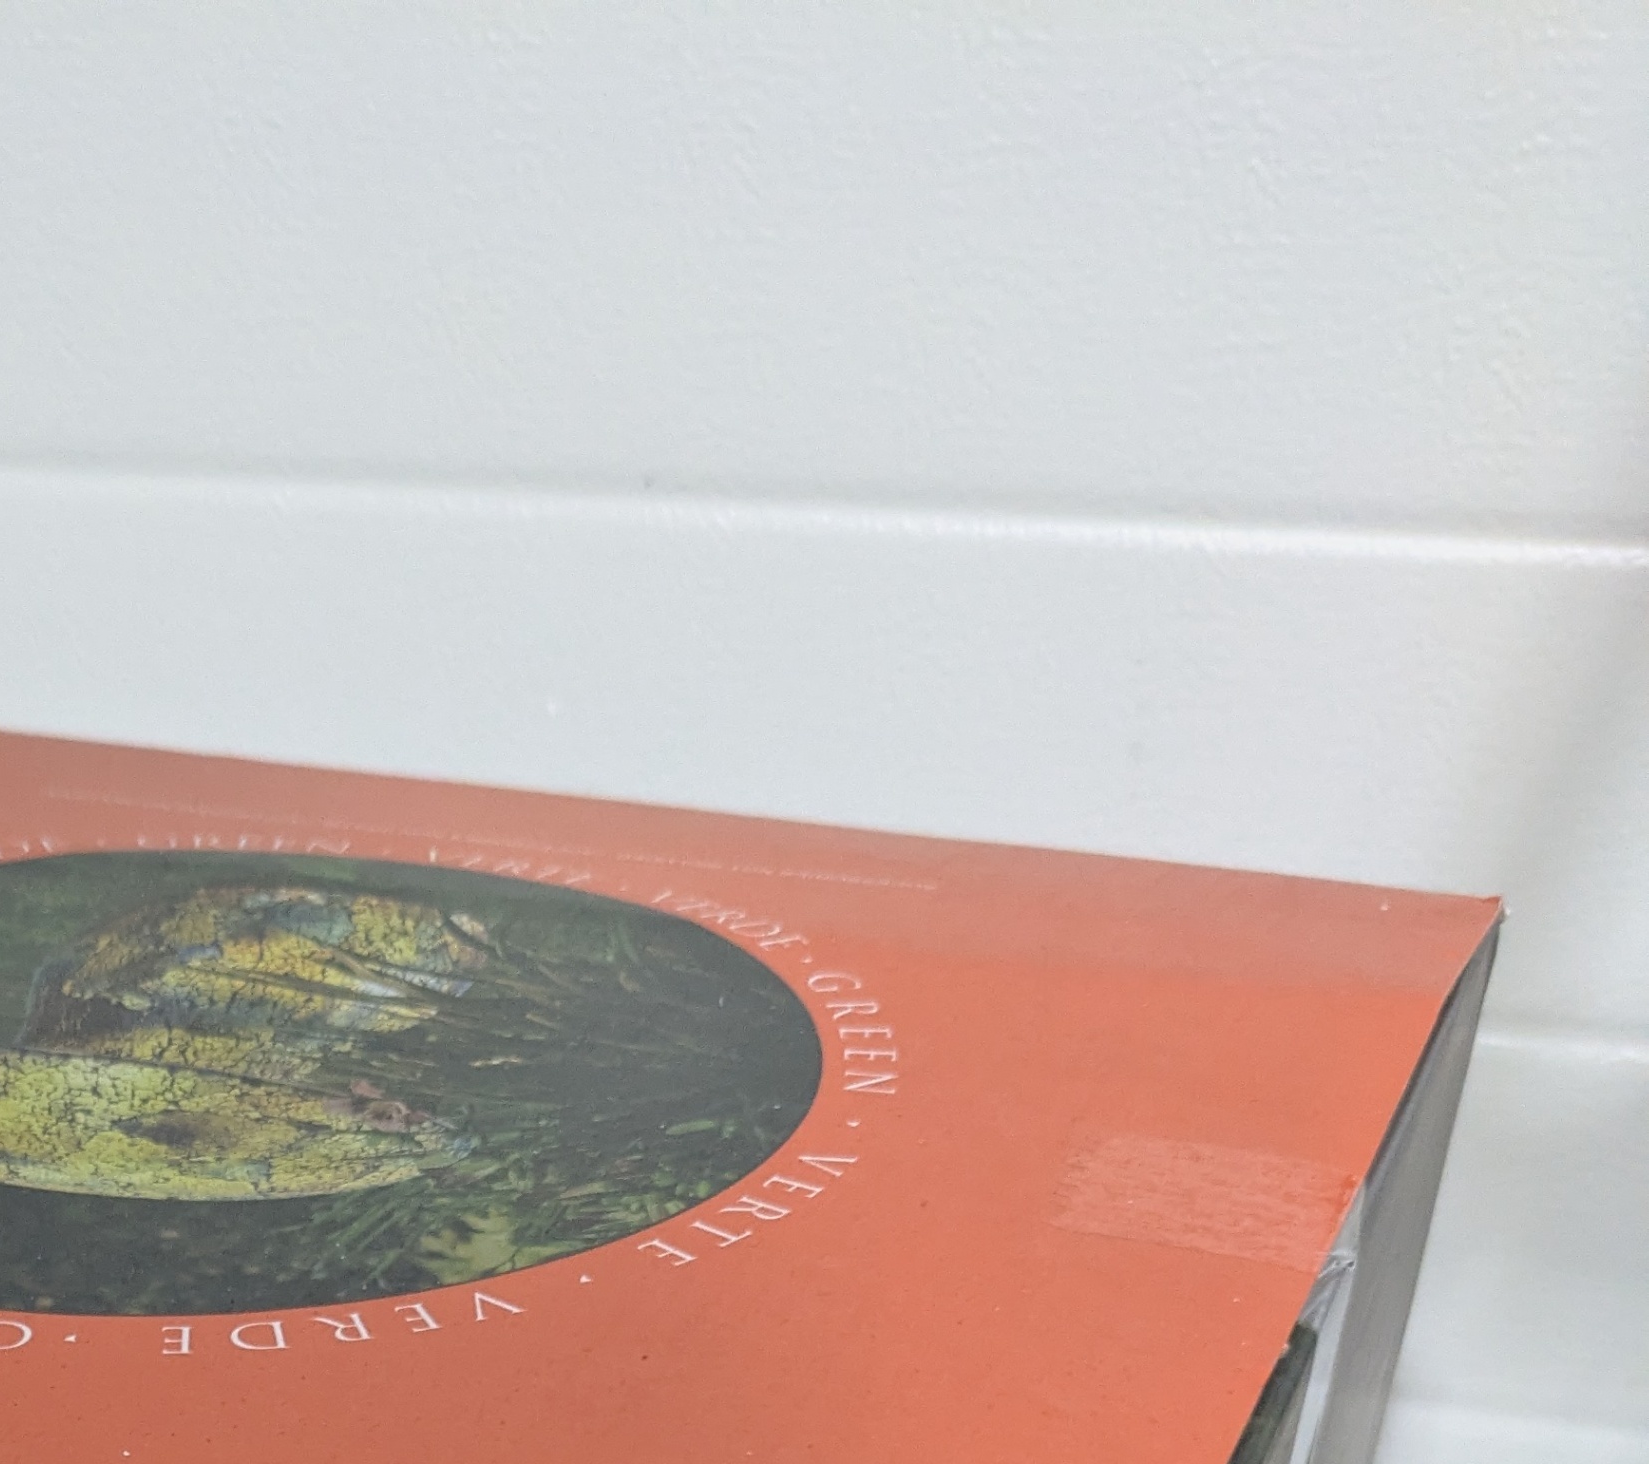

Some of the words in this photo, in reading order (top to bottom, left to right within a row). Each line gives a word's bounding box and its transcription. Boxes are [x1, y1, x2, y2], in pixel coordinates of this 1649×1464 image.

[808, 971, 899, 1097] GREEN
[638, 1151, 859, 1268] VERTE
[162, 1290, 526, 1357] VERDE
